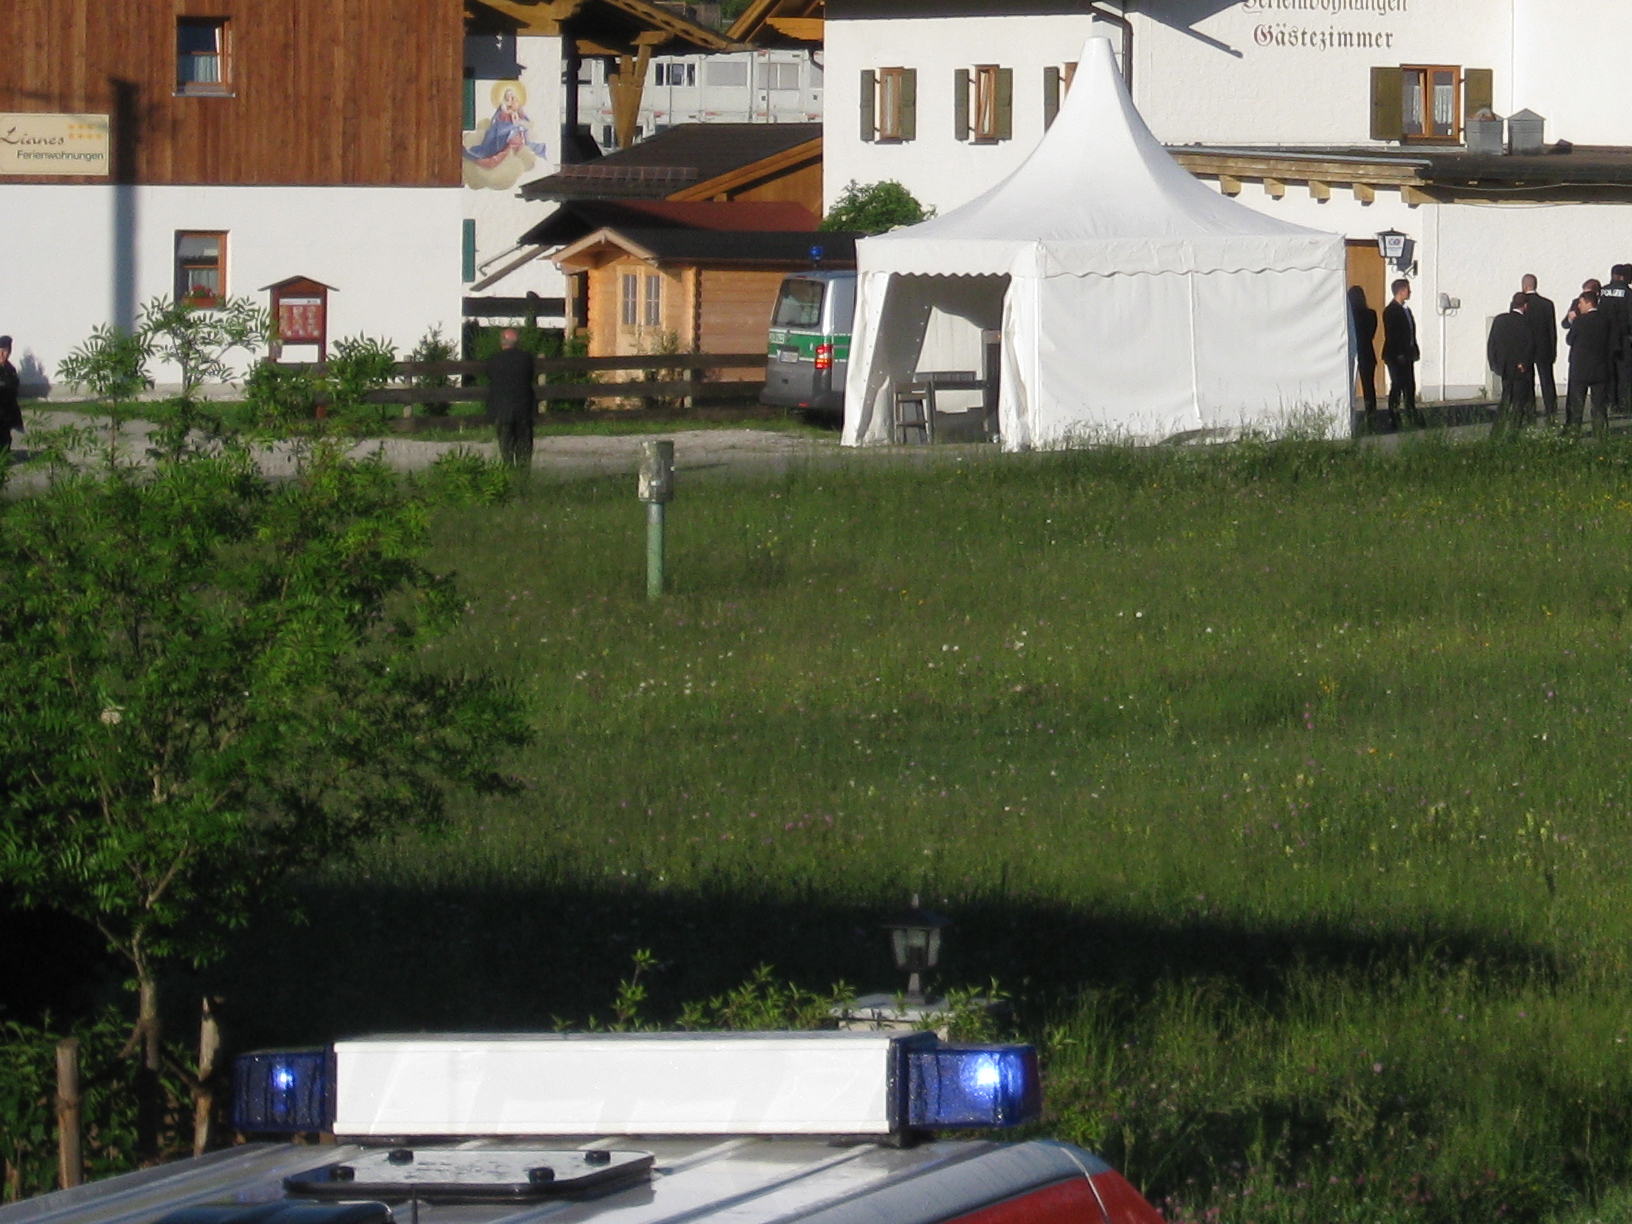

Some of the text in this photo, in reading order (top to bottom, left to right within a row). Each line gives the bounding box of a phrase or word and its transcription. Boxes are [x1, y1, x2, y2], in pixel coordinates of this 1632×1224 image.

[1253, 23, 1394, 52] Gästezimmer
[0, 126, 65, 145] Lianes
[17, 150, 104, 161] Ferienwohnungen
